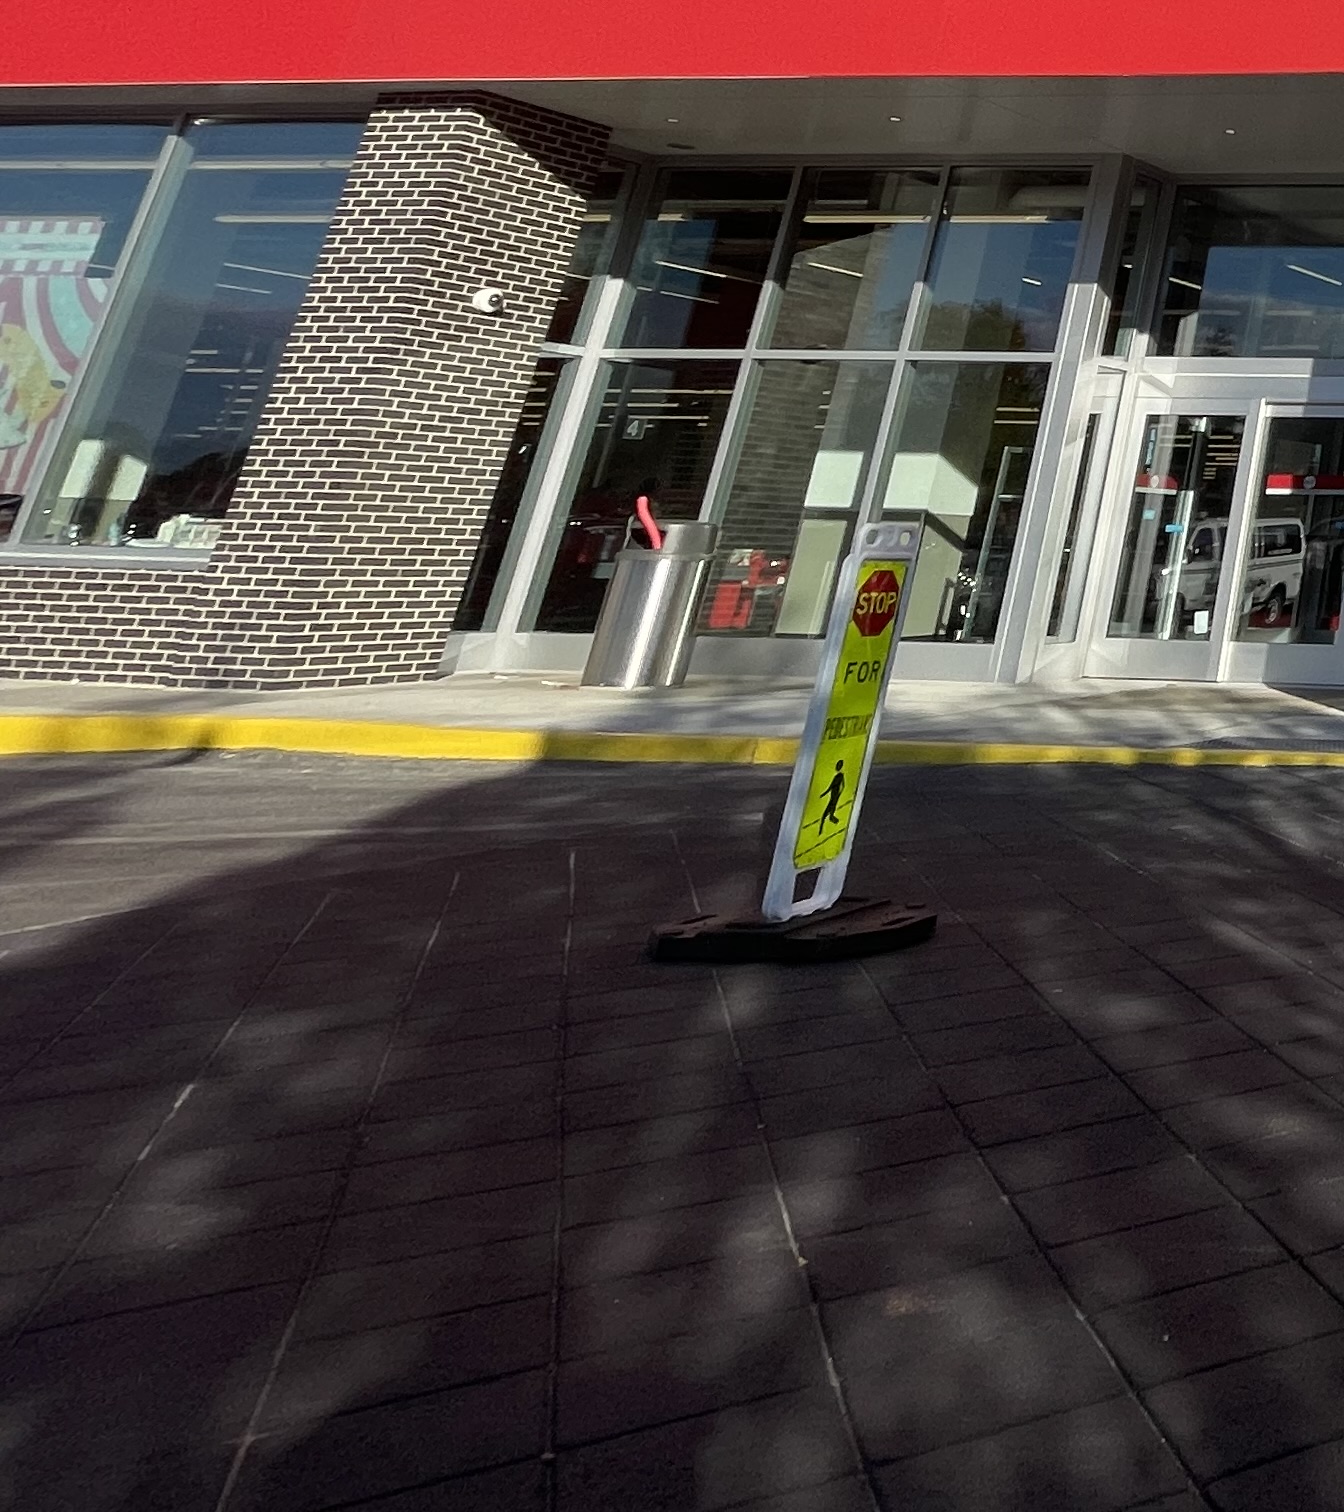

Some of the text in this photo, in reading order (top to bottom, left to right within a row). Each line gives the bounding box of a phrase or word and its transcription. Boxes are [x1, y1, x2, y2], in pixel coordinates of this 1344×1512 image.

[627, 420, 639, 436] 4
[856, 591, 897, 615] STOP
[843, 660, 881, 684] FOR
